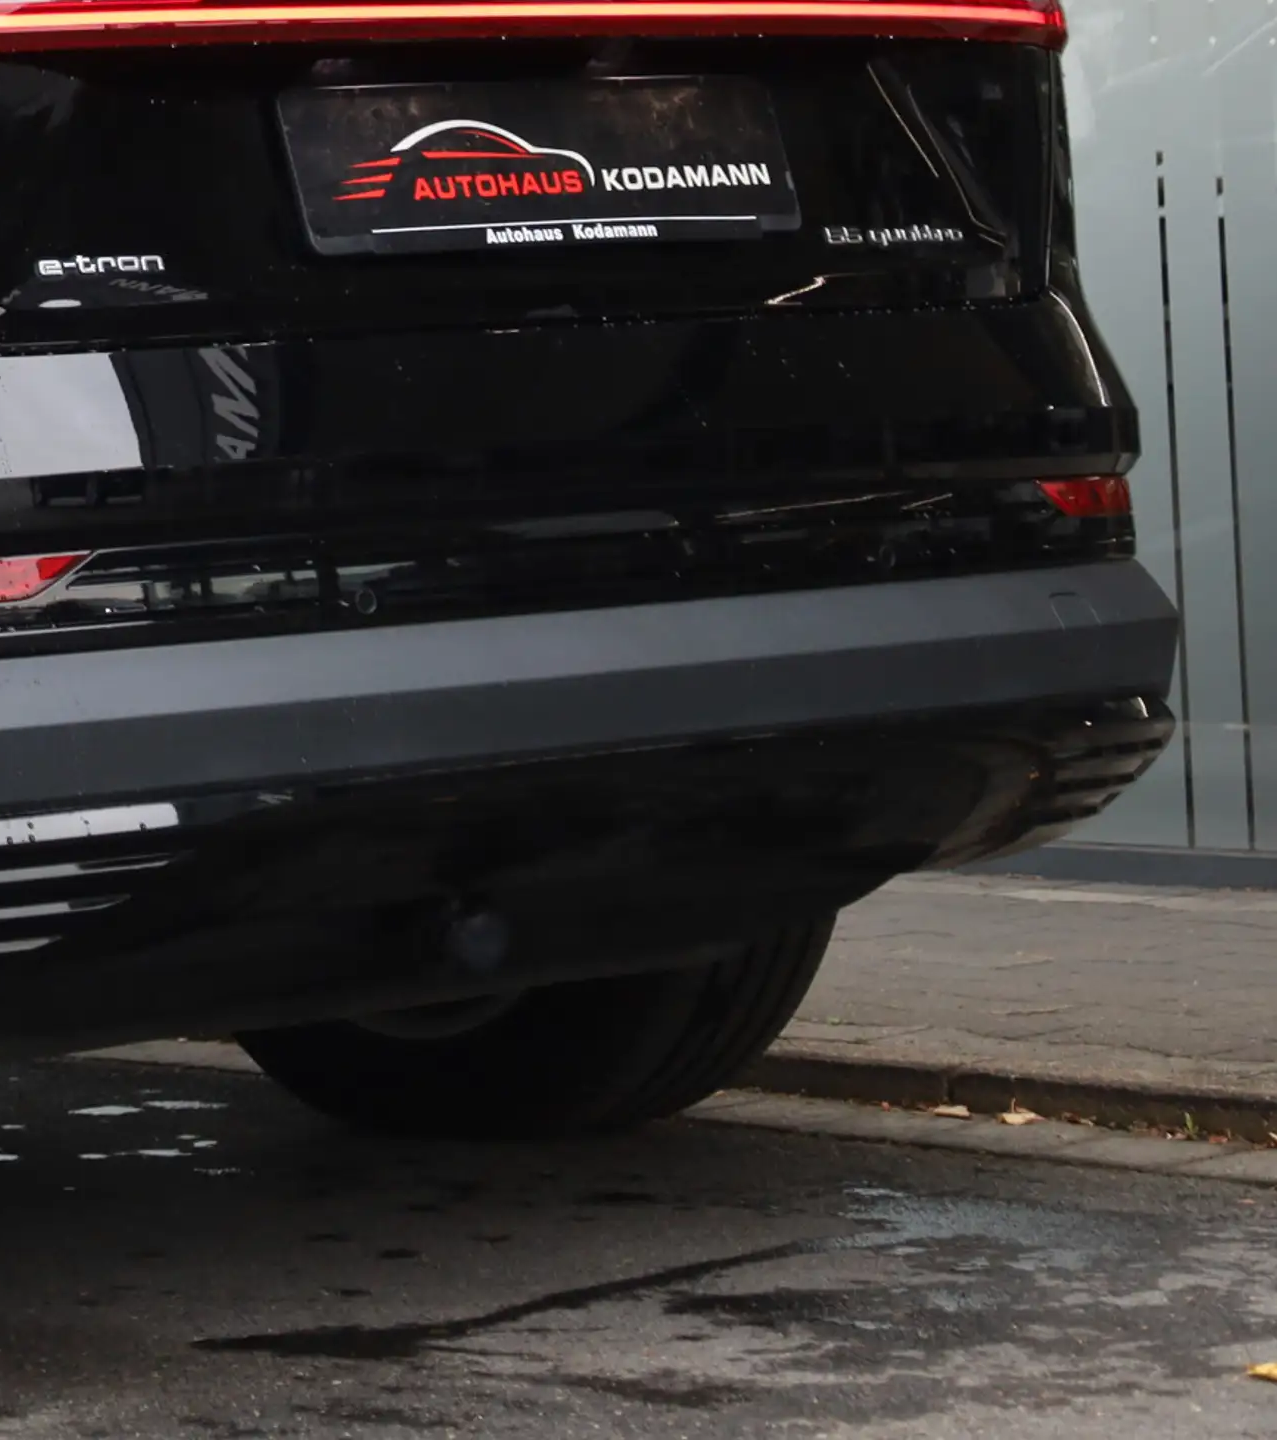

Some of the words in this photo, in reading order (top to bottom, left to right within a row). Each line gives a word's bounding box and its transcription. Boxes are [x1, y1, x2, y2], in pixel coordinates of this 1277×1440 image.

[413, 169, 584, 201] AUTOHAUS
[602, 163, 772, 192] KODAMANN
[486, 224, 564, 246] Autohaus
[574, 222, 659, 242] Kodamann
[37, 254, 166, 277] e-tron
